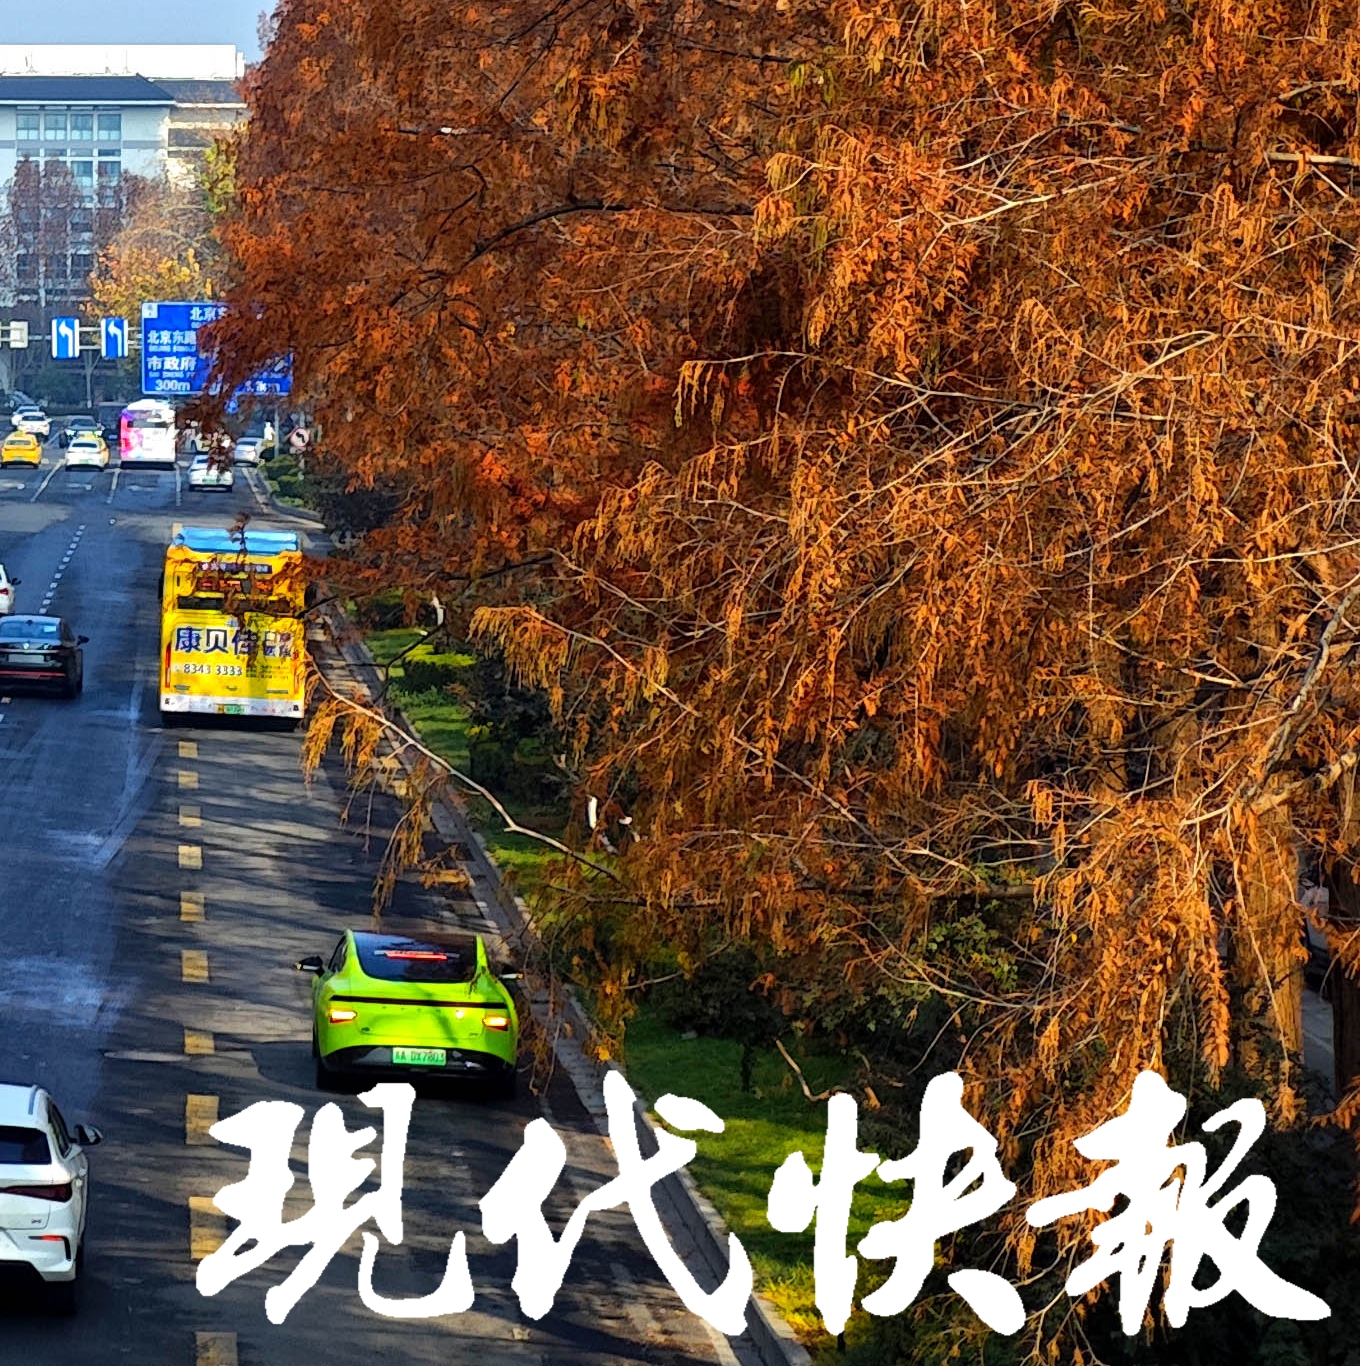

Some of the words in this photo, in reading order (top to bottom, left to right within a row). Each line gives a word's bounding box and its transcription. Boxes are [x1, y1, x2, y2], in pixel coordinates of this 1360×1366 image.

[147, 330, 197, 344] 北京东路
[147, 354, 197, 372] 市政府
[155, 378, 191, 391] 300m
